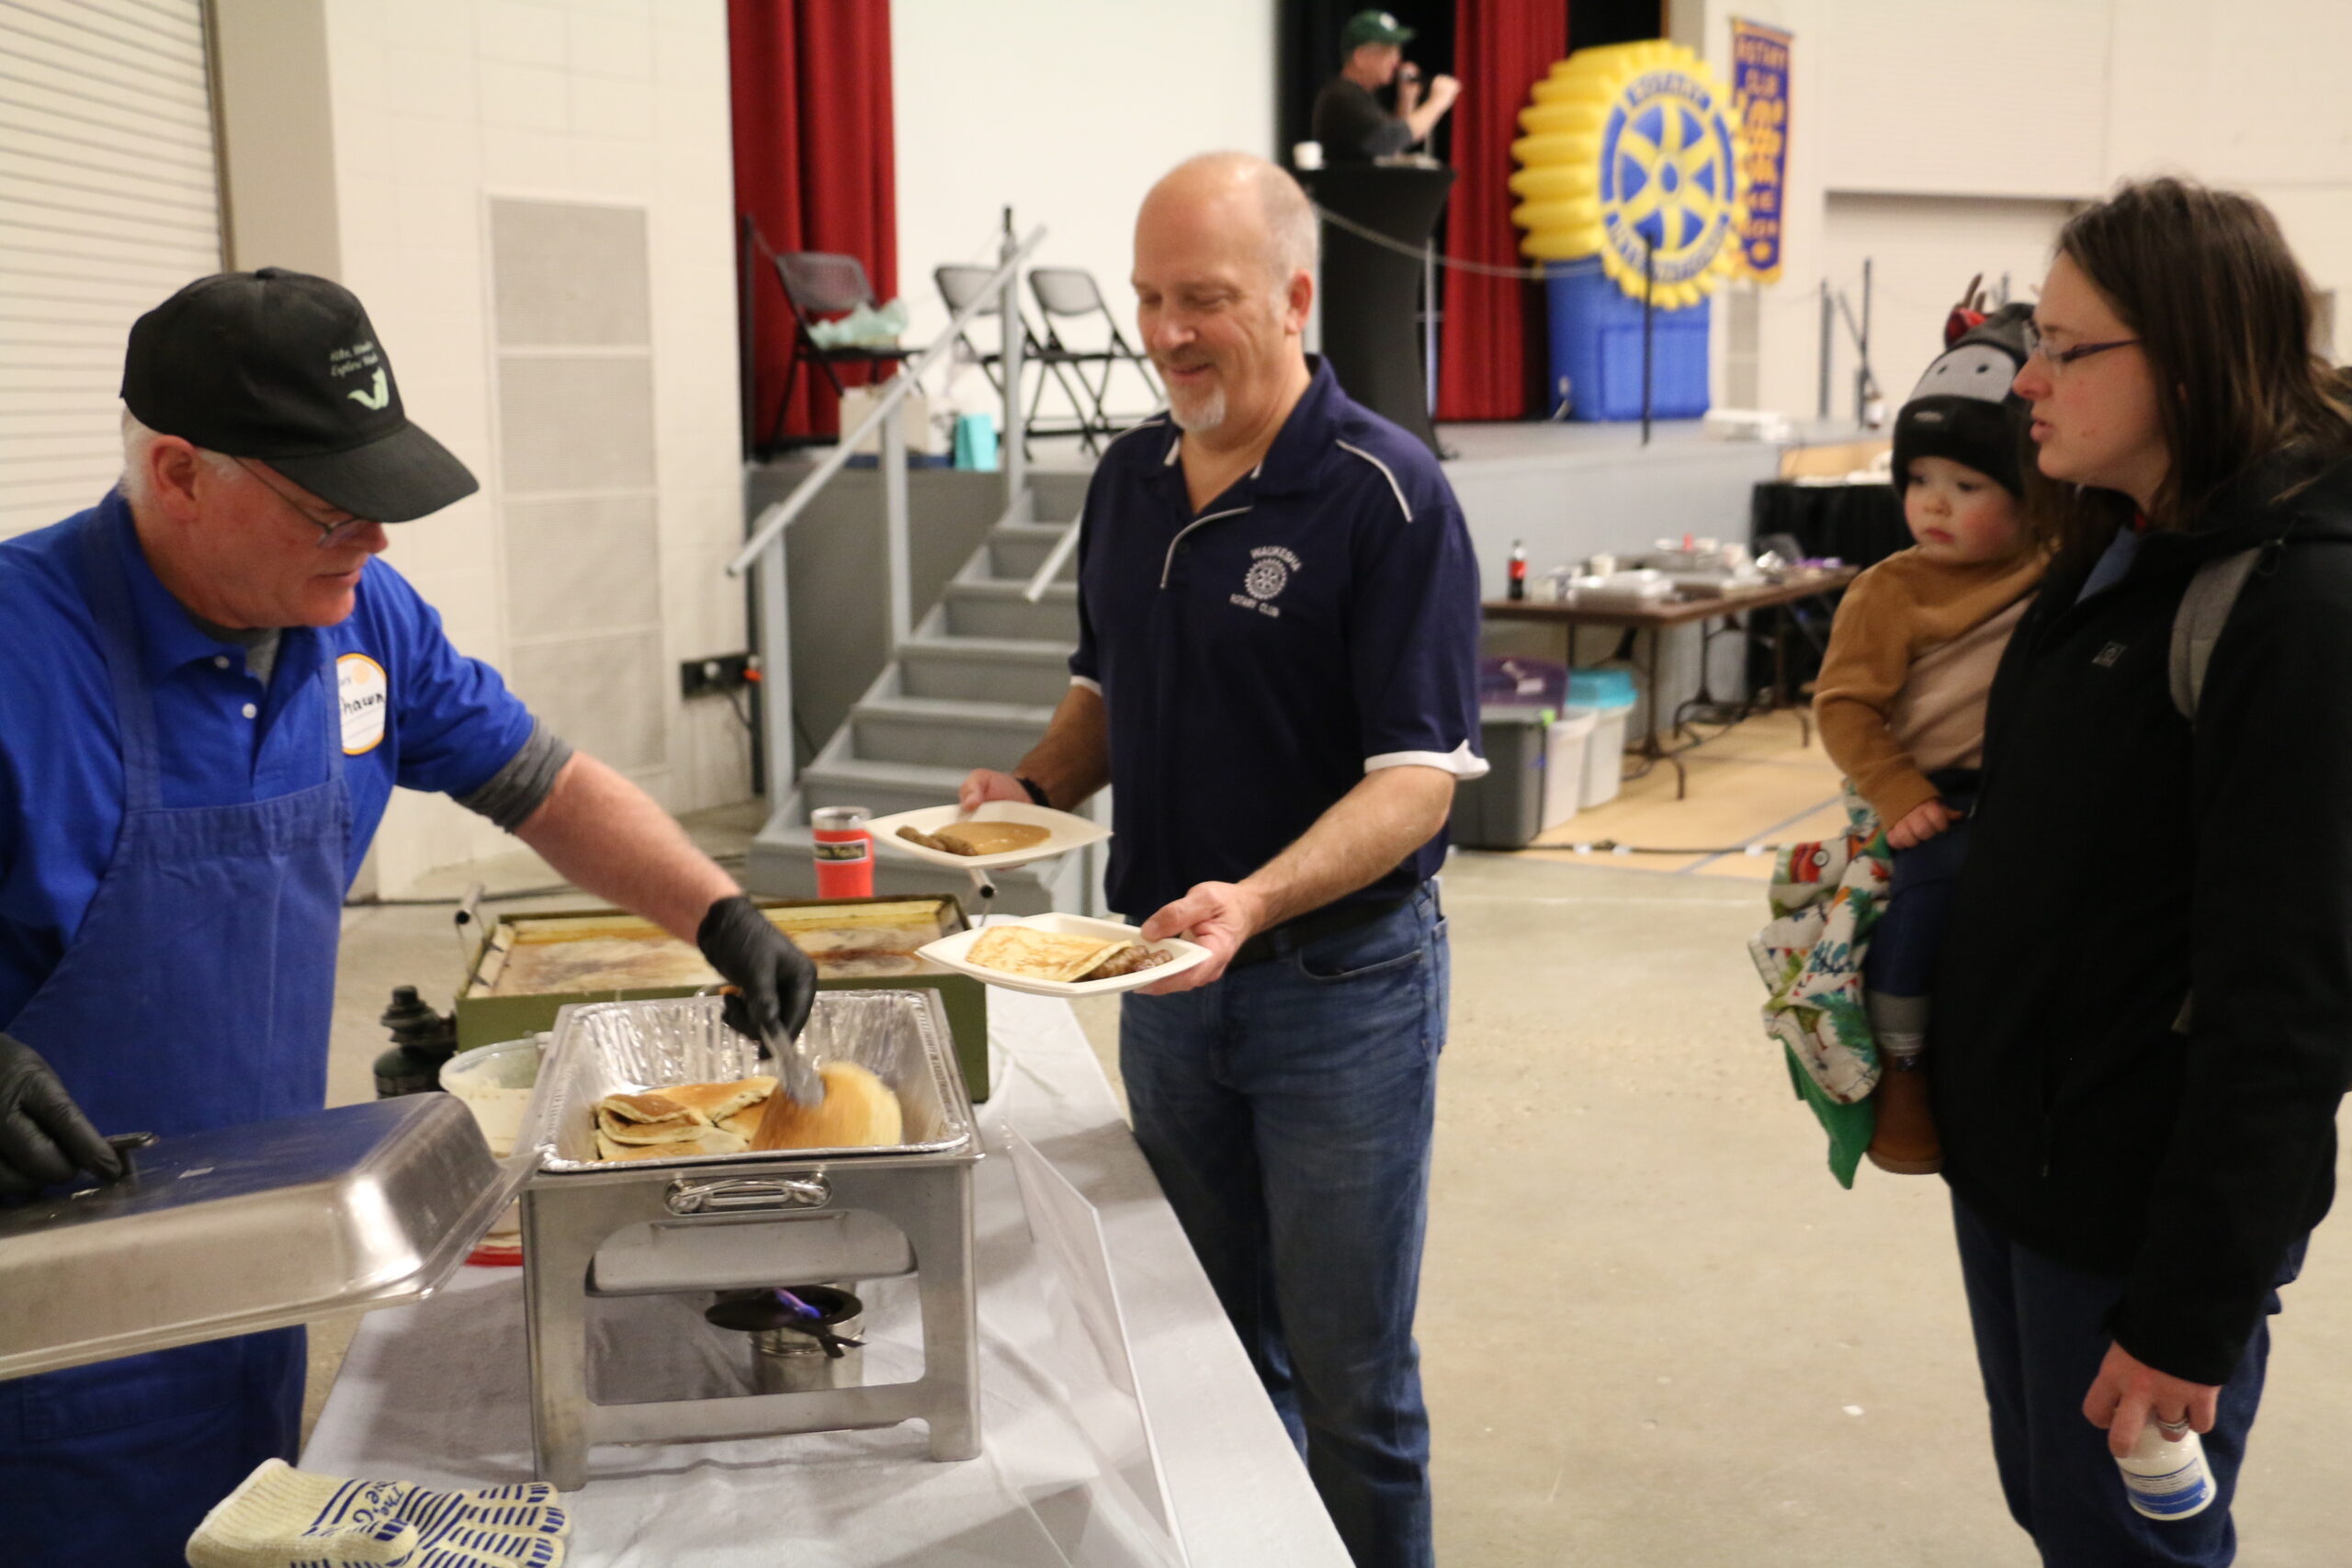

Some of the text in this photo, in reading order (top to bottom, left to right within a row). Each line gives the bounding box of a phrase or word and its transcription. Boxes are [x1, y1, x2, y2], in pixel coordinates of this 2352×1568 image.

[1250, 546, 1302, 571] WAUKESHA
[1230, 593, 1280, 618] ROTARY CLUB
[341, 694, 385, 714] hawn
